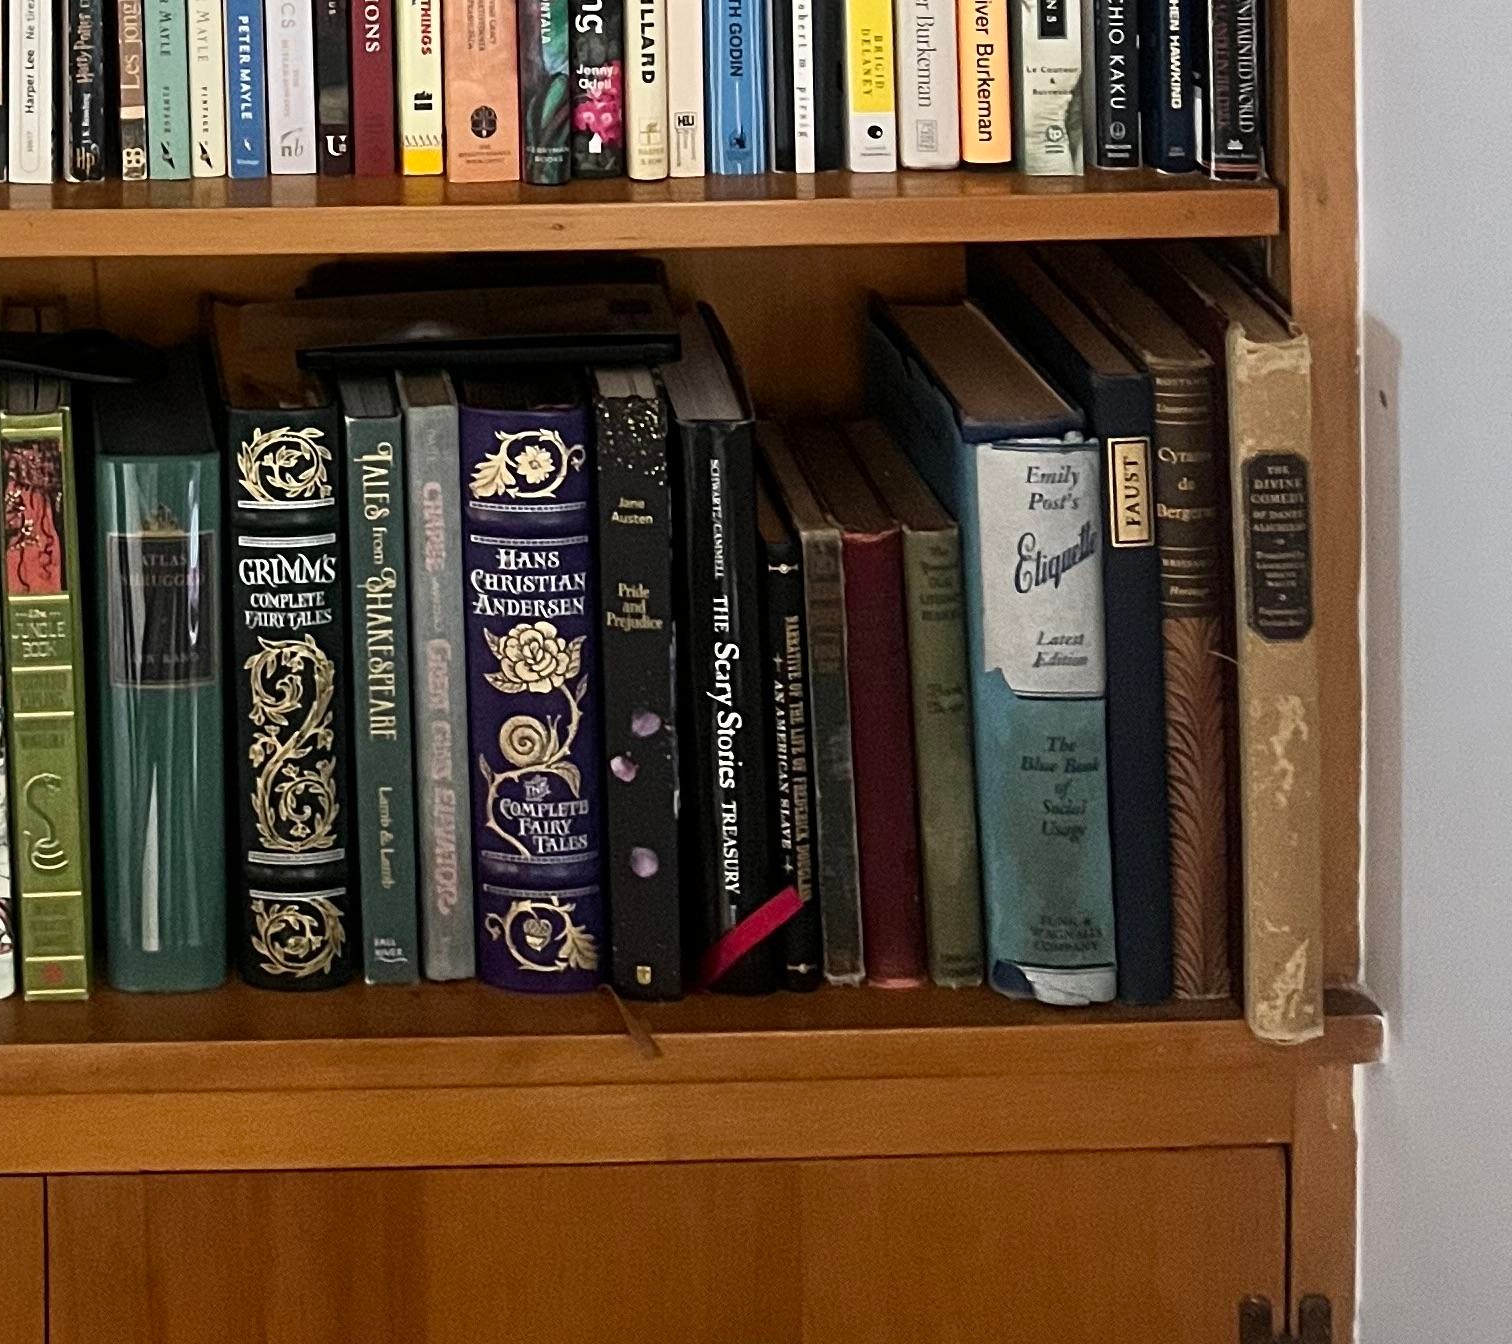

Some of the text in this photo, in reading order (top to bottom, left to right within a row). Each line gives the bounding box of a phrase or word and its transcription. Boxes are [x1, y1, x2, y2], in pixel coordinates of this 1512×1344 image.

[975, 43, 995, 142] Burkeman
[1109, 55, 1126, 109] KAKU
[1125, 457, 1141, 528] FAUST
[239, 554, 336, 586] GRIMM'S
[496, 549, 559, 570] HANS
[470, 570, 585, 594] CHRISTIAN
[472, 595, 585, 617] ANDERSEN
[706, 595, 742, 894] THE Scary Stories TREASURY
